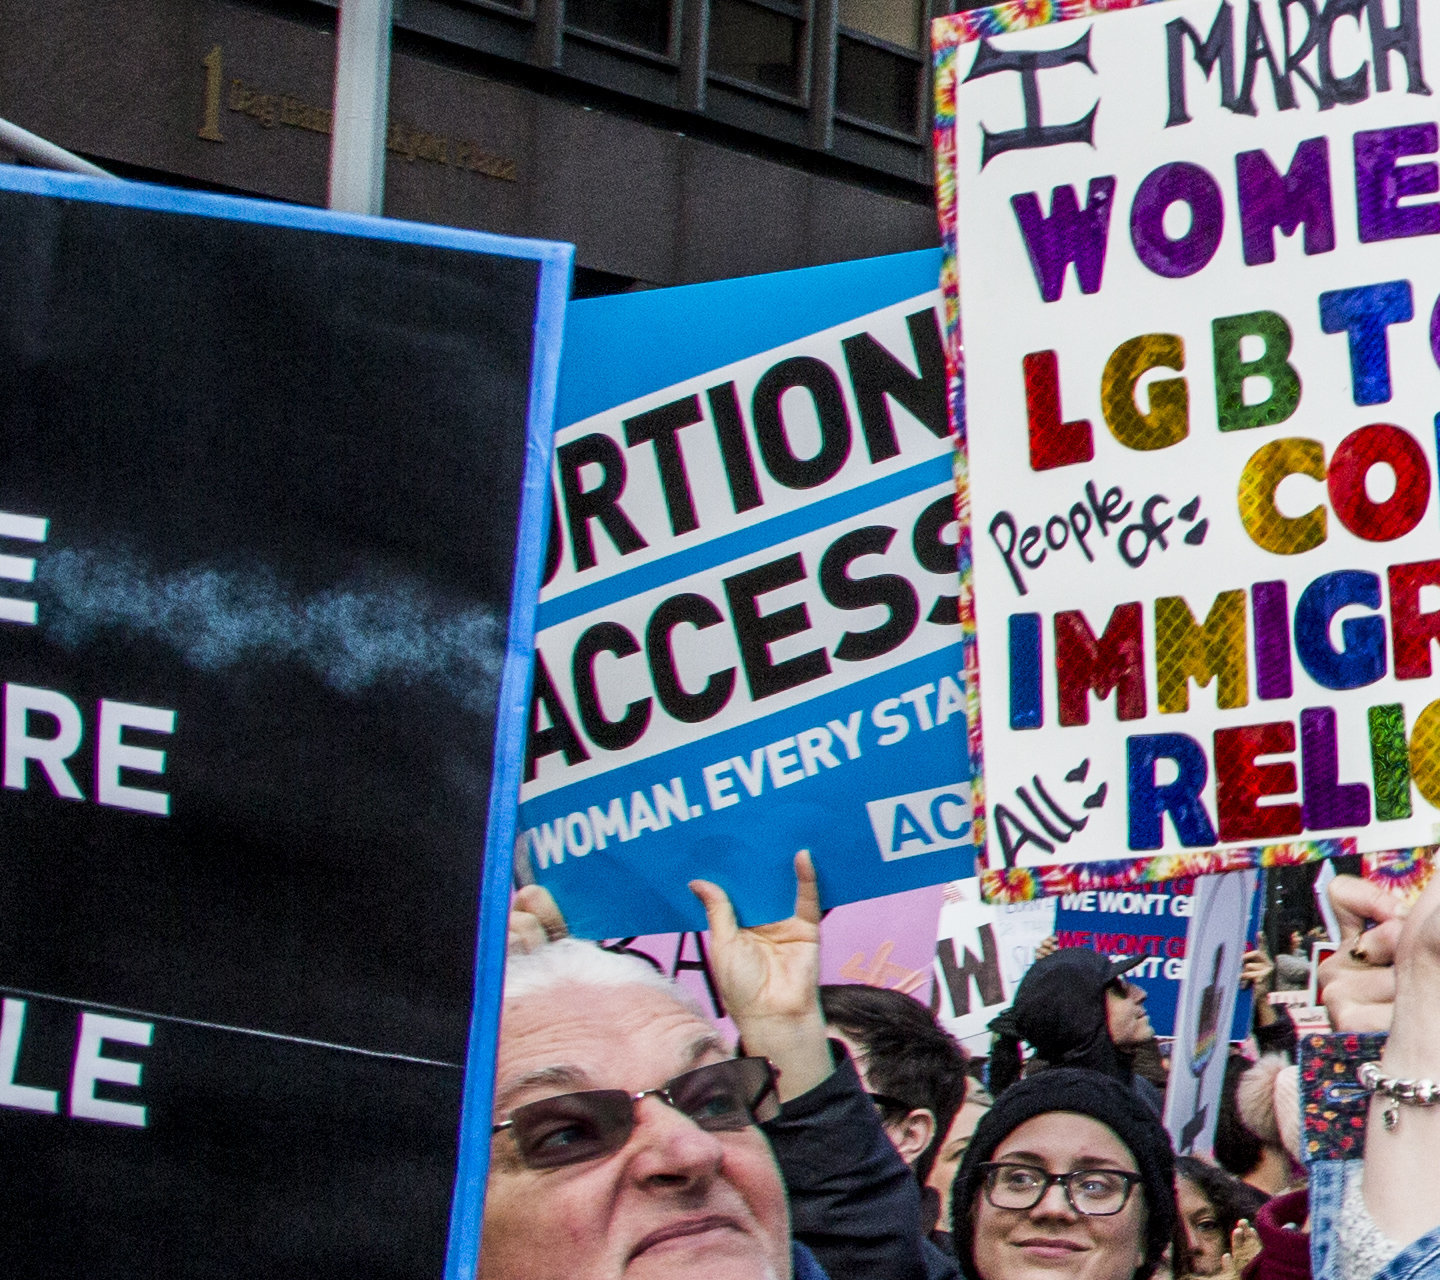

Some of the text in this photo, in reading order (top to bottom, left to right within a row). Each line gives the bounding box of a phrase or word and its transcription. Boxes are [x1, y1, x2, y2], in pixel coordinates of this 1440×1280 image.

[963, 25, 1096, 172] I
[988, 480, 1133, 596] People
[703, 711, 863, 811] EVERY
[872, 670, 968, 746] STA
[1061, 891, 1097, 911] WE
